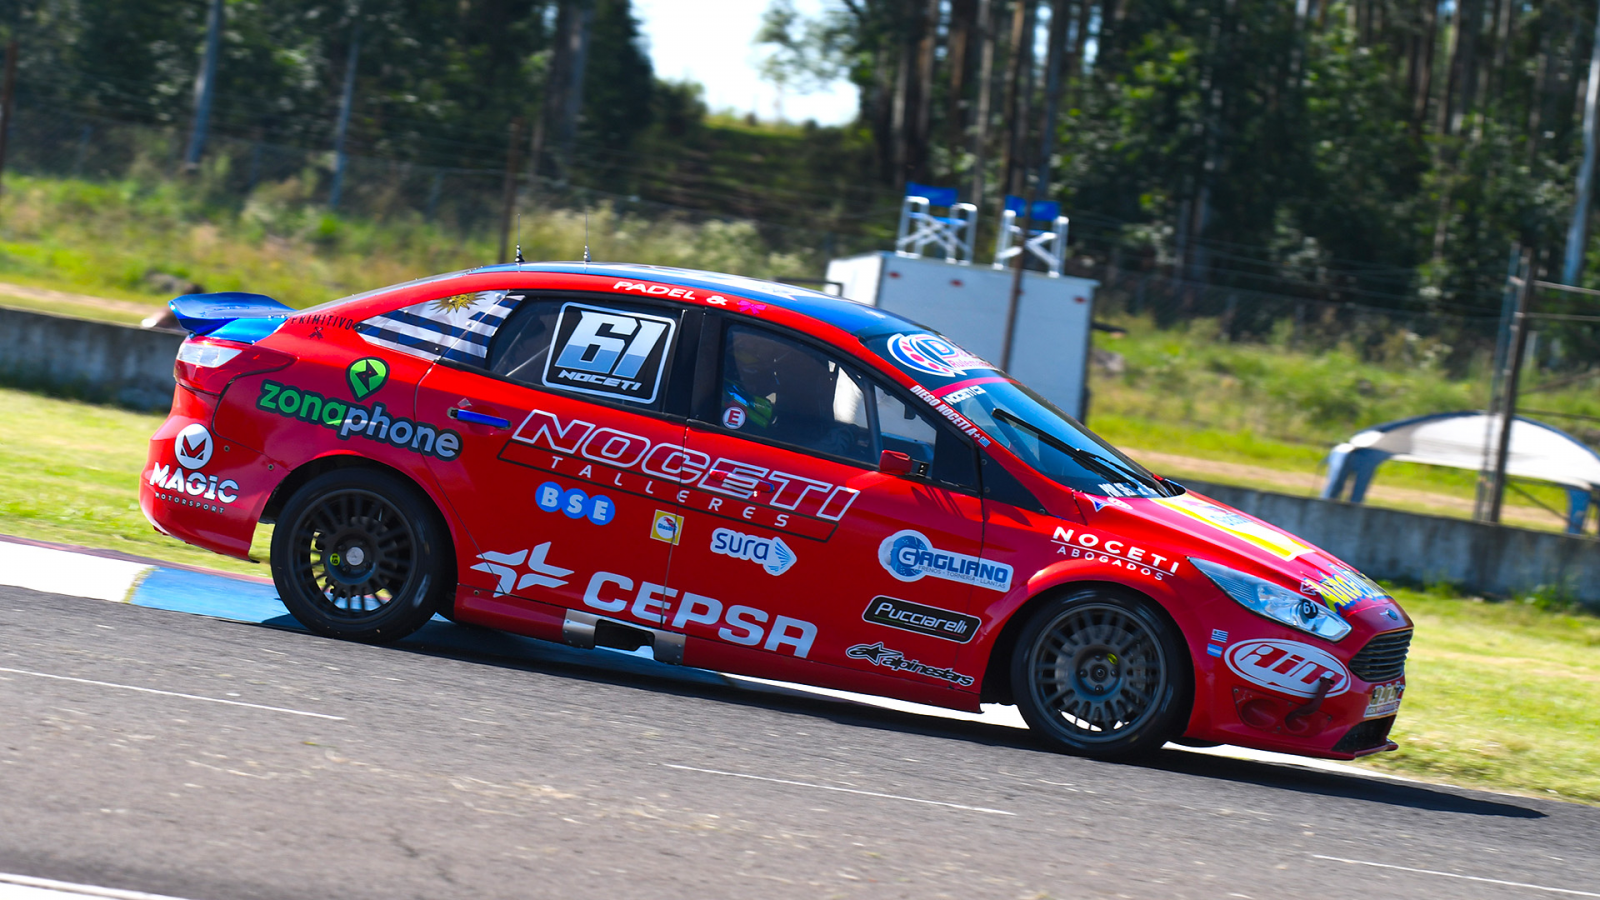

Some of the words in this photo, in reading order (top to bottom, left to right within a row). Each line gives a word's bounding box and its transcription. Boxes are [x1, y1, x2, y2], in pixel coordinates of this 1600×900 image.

[613, 281, 695, 300] PADEL
[706, 295, 728, 306] &
[554, 310, 667, 379] 61
[557, 369, 643, 391] NOCETI
[259, 383, 459, 457] zonaphone
[728, 410, 740, 424] E
[909, 385, 941, 406] DIEGO
[935, 404, 972, 430] NOCETI
[512, 409, 861, 521] NOCETI
[155, 492, 225, 514] MOTORSPORT
[540, 486, 608, 521] BSE
[551, 455, 789, 528] TALLERES
[714, 532, 770, 560] sura
[1052, 526, 1179, 573] NOCETI
[1057, 546, 1163, 580] ABOGADOS
[898, 546, 1008, 583] GAGLIANO
[918, 565, 941, 574] FRENOS
[980, 579, 1006, 589] LLANTAS
[582, 571, 818, 659] CEPSA
[874, 602, 967, 634] Pucciarelli
[1303, 601, 1316, 614] 61
[881, 655, 974, 687] alpinestars
